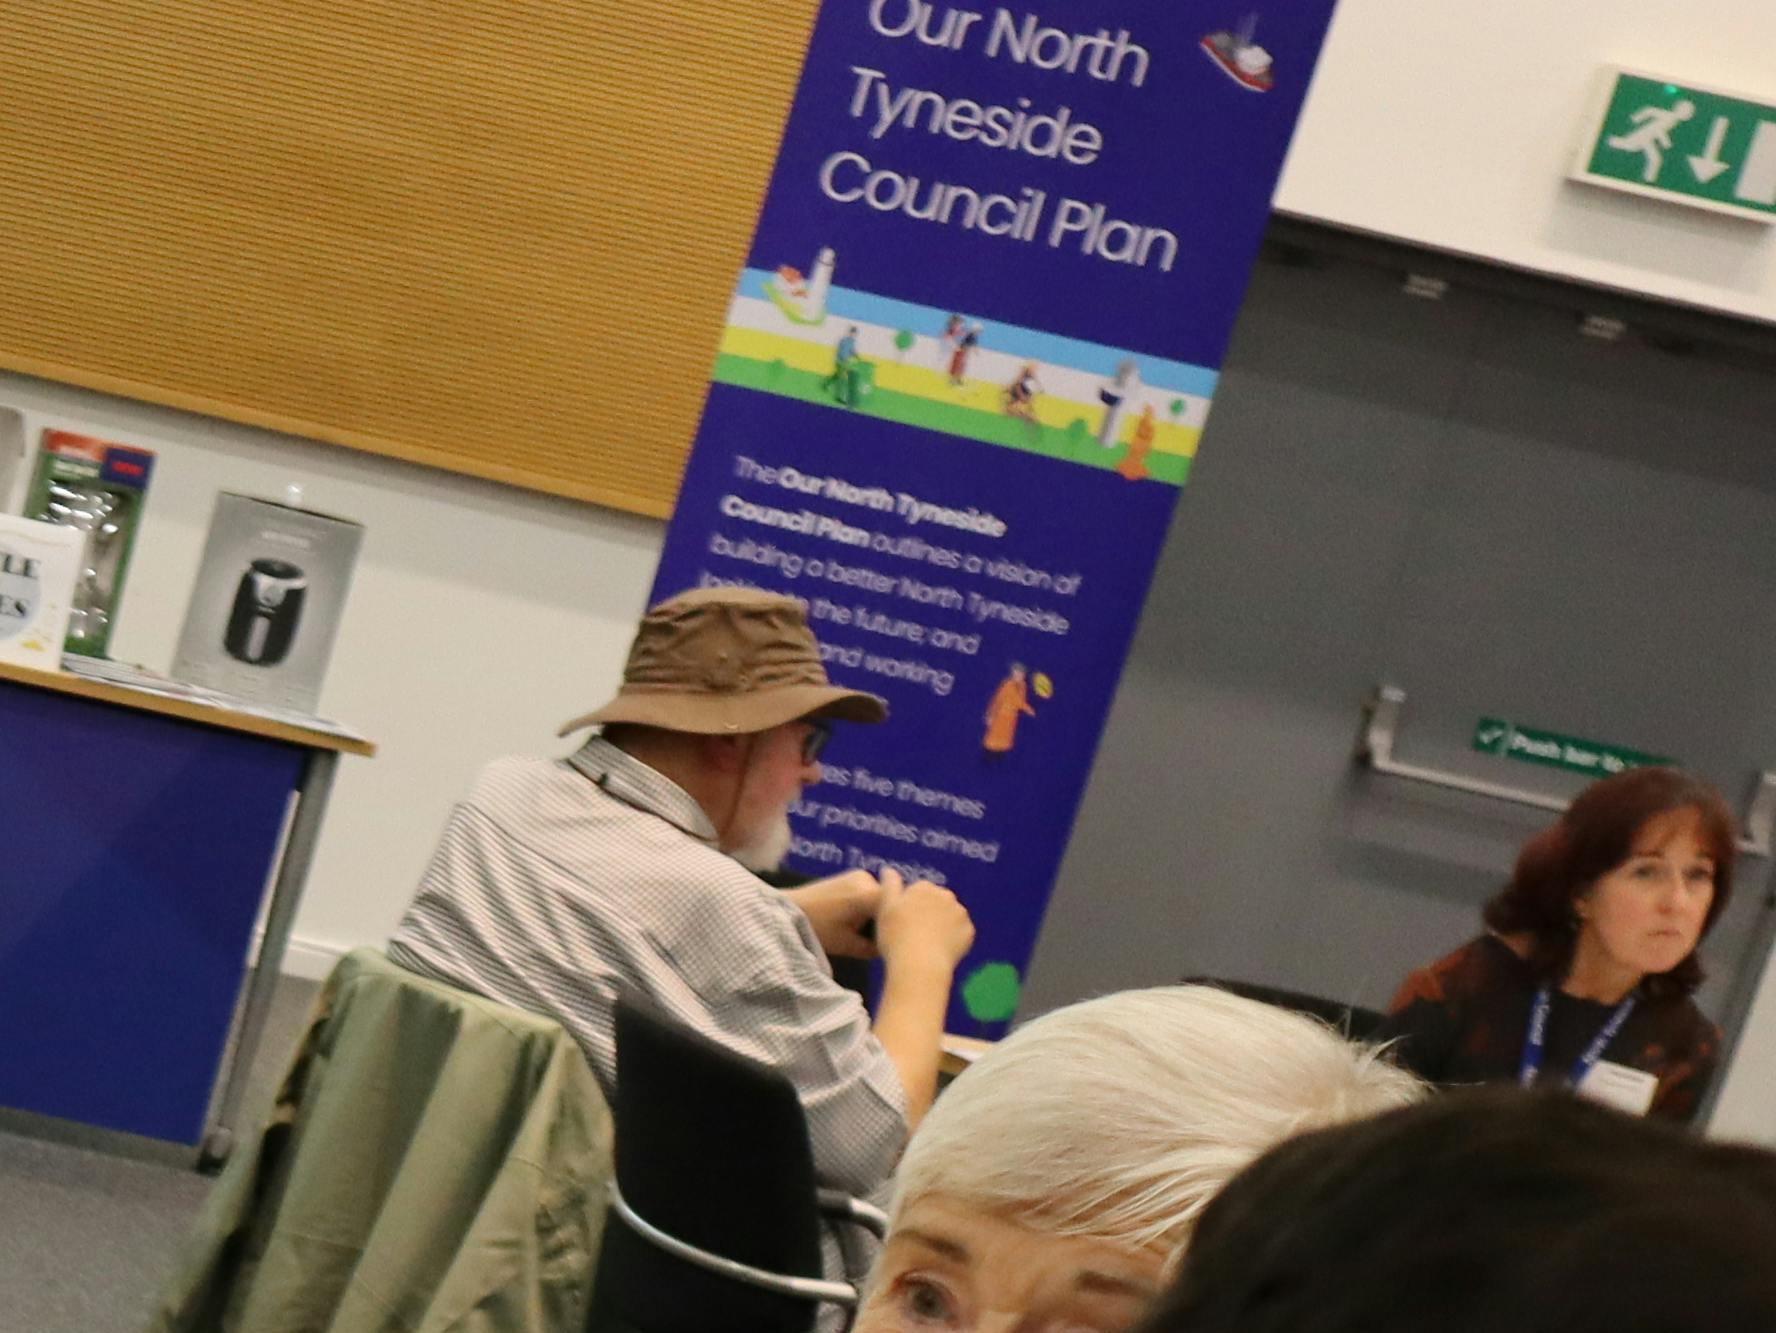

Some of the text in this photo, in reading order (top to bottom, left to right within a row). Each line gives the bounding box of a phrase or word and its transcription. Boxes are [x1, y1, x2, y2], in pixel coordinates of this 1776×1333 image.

[868, 0, 1149, 87] Our North
[848, 65, 1103, 165] Tyneside
[818, 150, 1179, 272] Council Plan
[736, 455, 1008, 537] The Our North Tyneside
[708, 534, 1070, 635] building a better North Tyneside
[720, 494, 1083, 595] Council Plan outlines a vision of
[812, 599, 850, 624] the
[930, 627, 982, 655] and
[864, 654, 955, 696] working
[820, 806, 918, 843] priorities
[921, 830, 999, 863] aimed
[897, 780, 985, 820] themes
